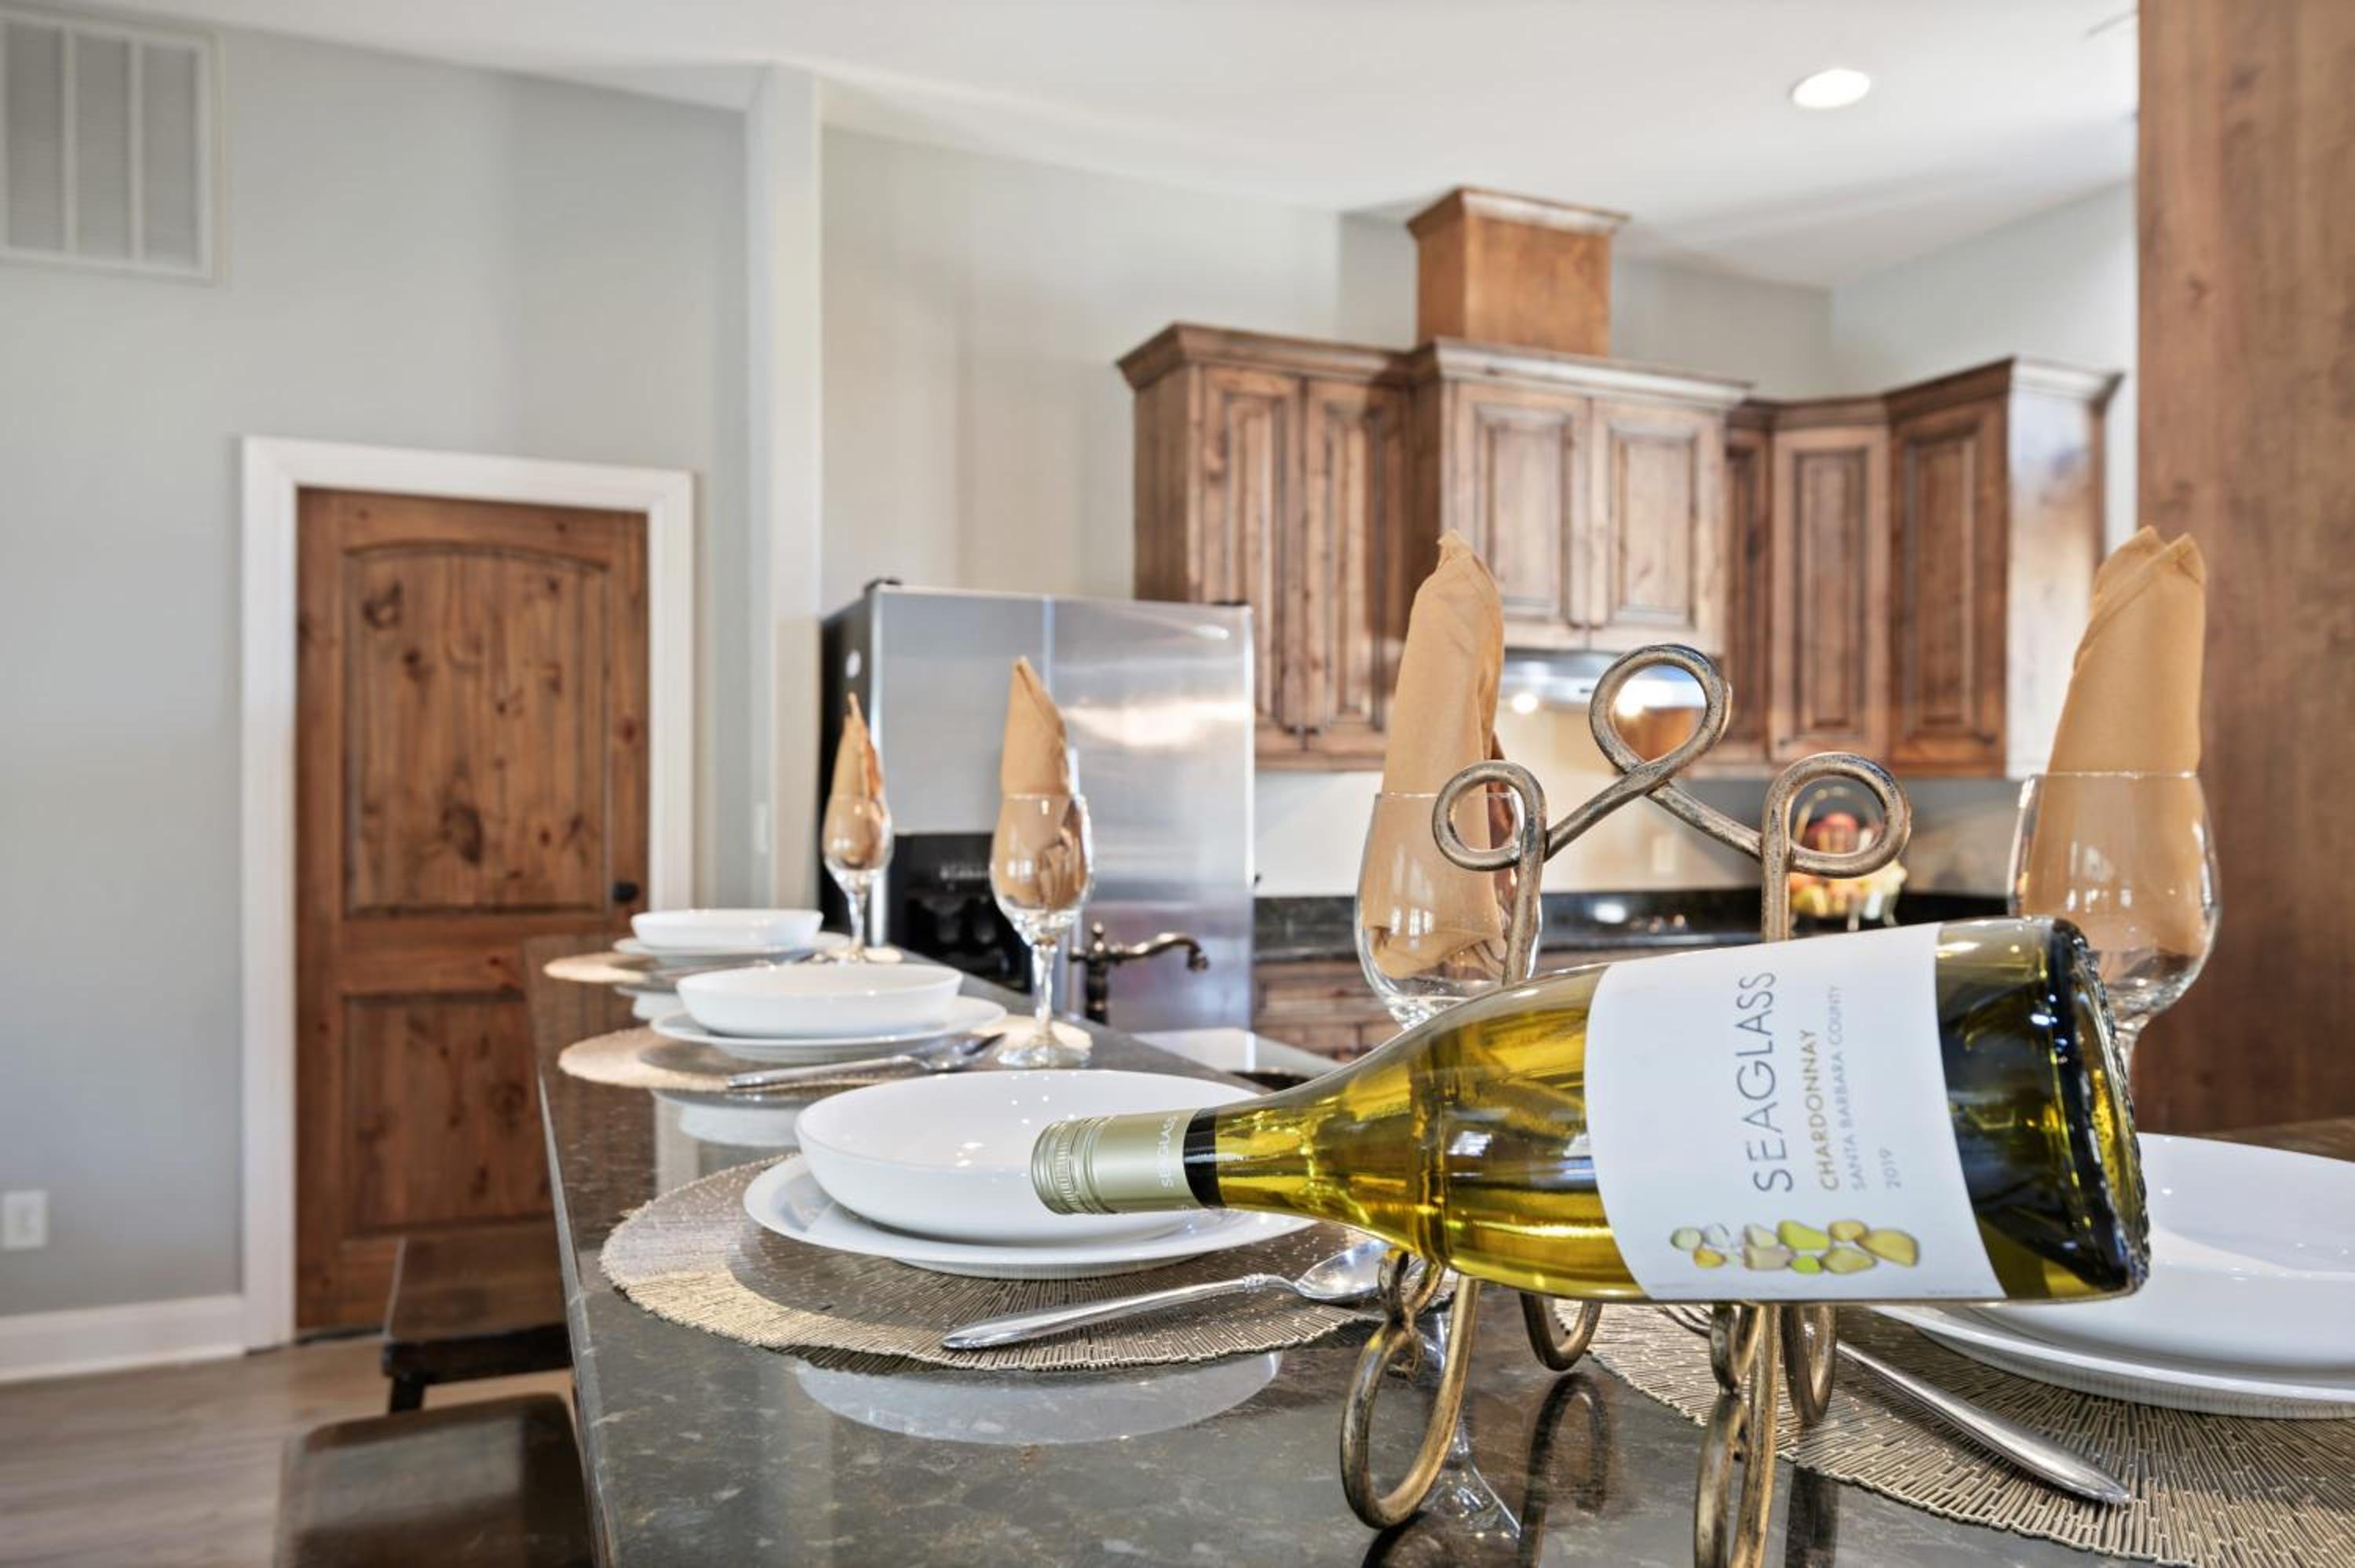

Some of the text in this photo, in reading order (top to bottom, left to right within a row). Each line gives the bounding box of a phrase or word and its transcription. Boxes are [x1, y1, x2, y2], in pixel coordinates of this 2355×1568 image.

[1735, 972, 1794, 1193] SEAGLASS
[1799, 1029, 1840, 1191] CHARDONNAY
[1827, 984, 1867, 1191] SANTA BARBARA COUNTY
[1878, 1147, 1902, 1190] 2019
